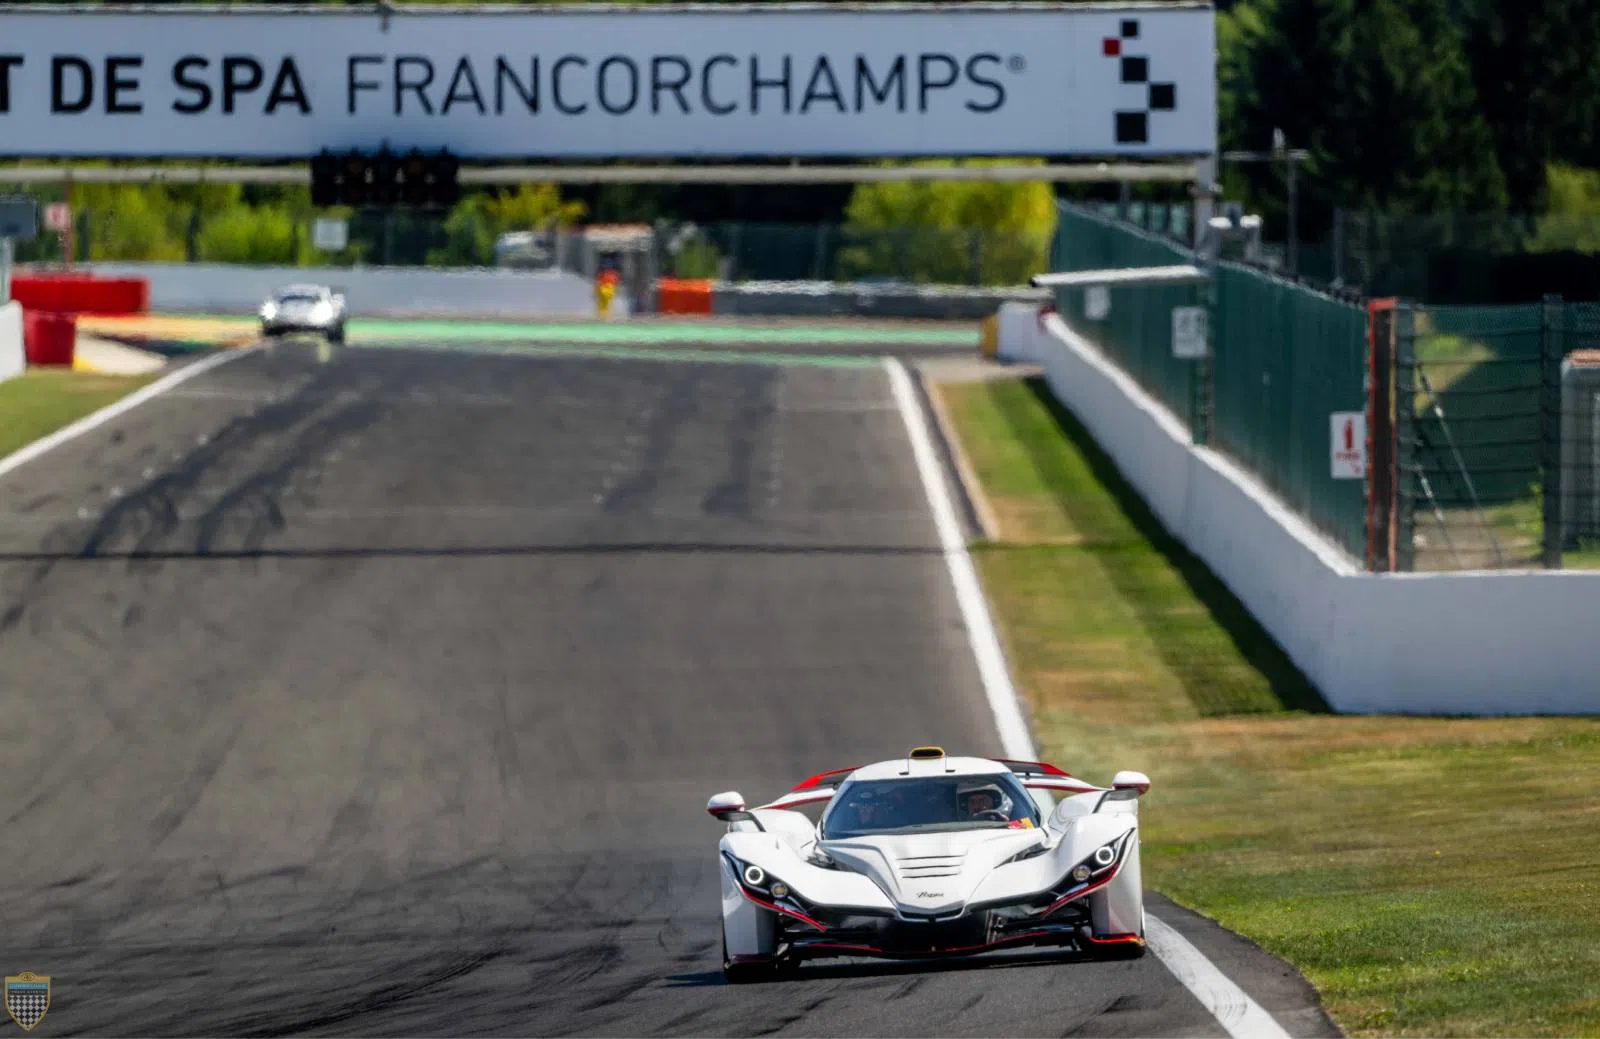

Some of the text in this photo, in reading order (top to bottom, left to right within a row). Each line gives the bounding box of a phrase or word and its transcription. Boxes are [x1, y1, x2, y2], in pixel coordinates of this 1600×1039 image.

[50, 54, 145, 115] DE
[170, 54, 311, 115] SPA
[346, 53, 1008, 117] FRANCORCHAMPS
